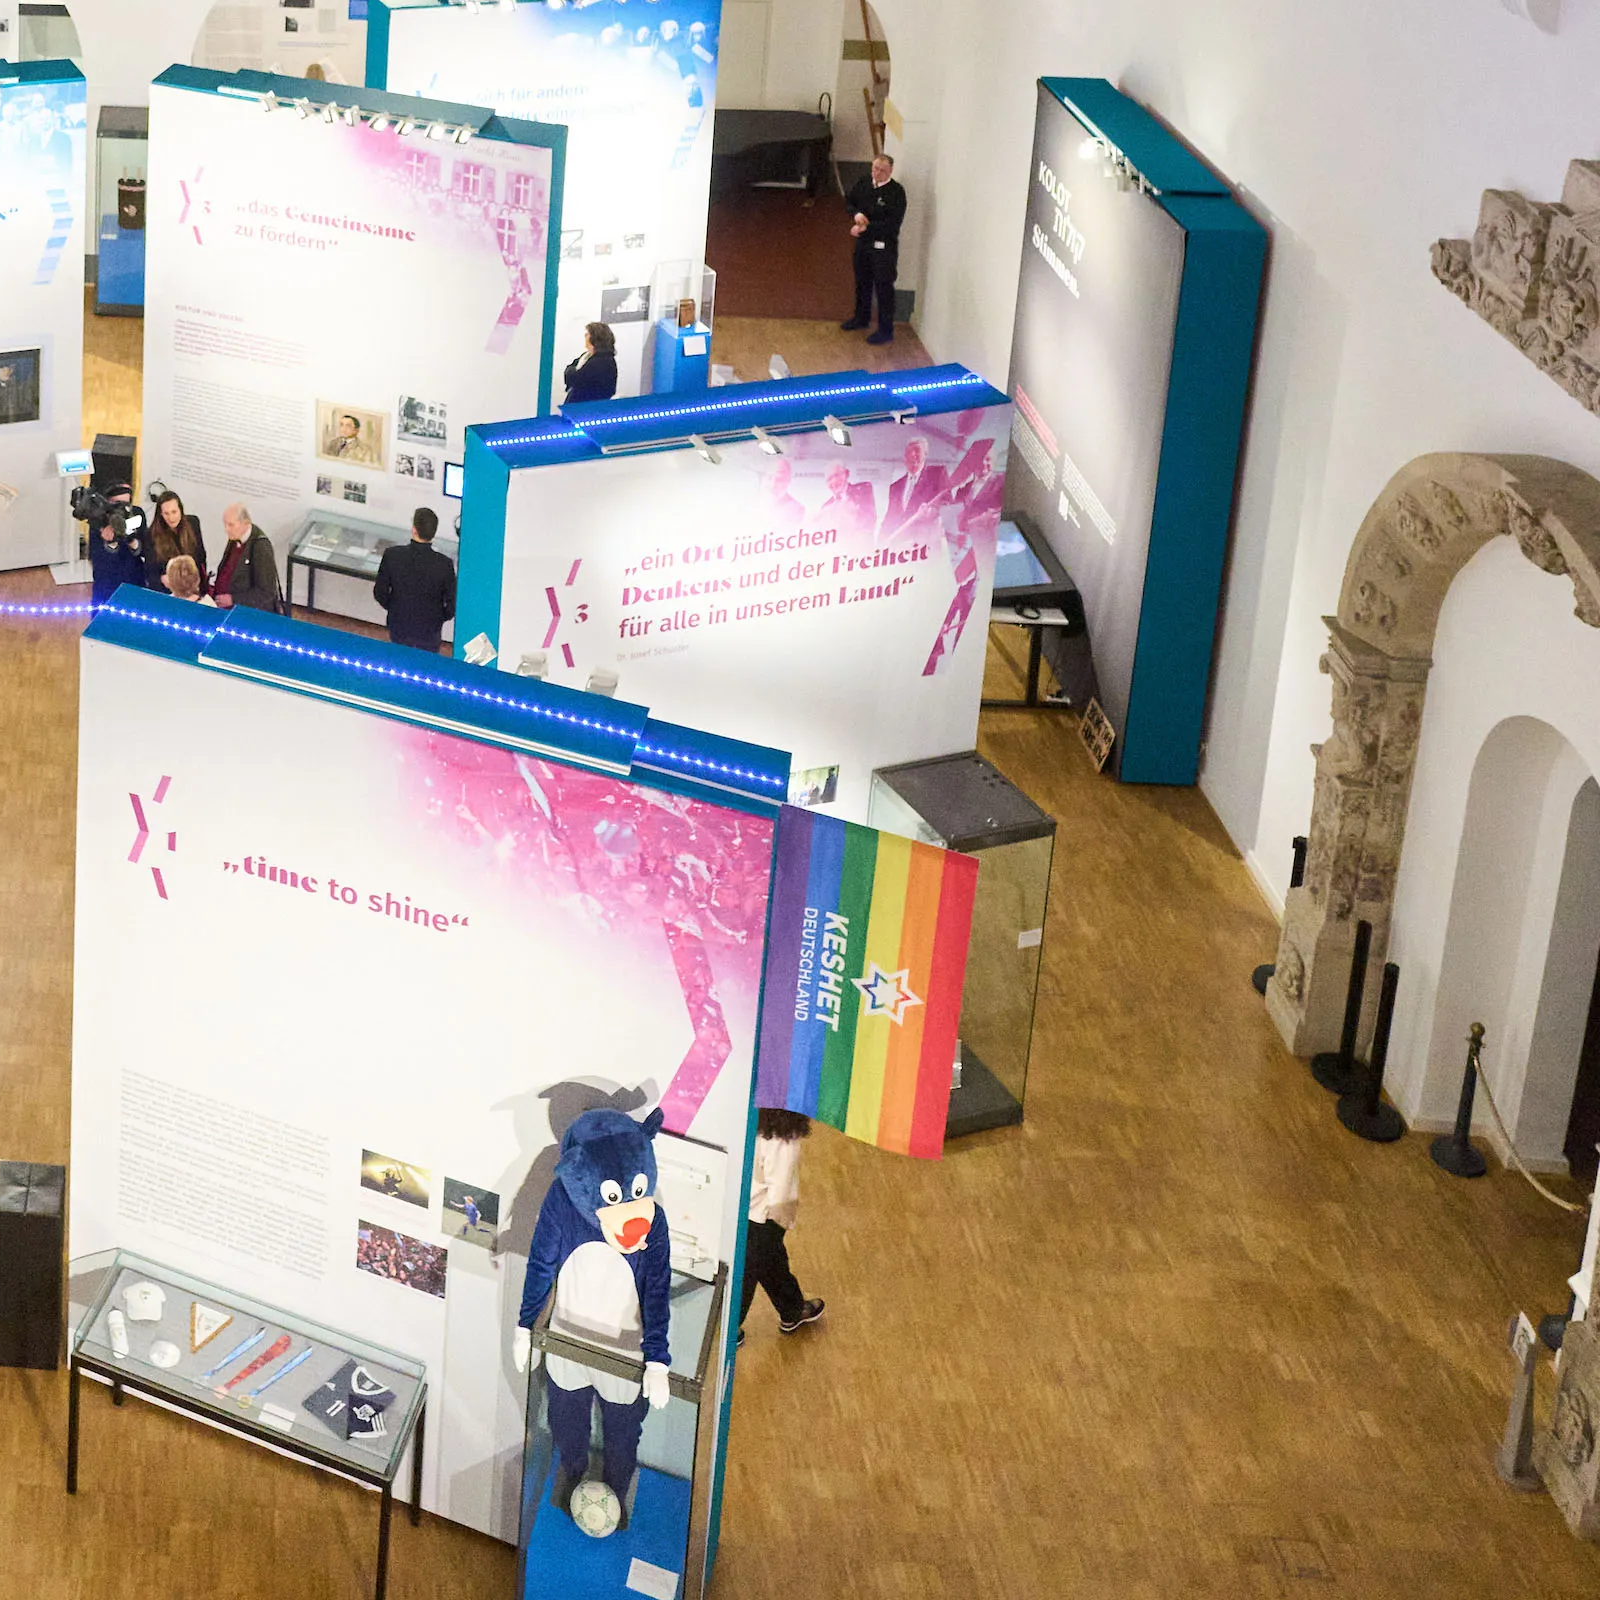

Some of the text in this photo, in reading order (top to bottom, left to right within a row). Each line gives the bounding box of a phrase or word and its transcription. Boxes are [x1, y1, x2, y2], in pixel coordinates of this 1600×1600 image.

[1039, 161, 1072, 213] KOLOT
[234, 223, 339, 251] zu fördern“
[284, 205, 416, 242] Gemeinsame
[1032, 224, 1080, 299] Stimmen.
[620, 543, 931, 606] Denkens und der Freiheit
[623, 527, 837, 576] „ein Ort jüdischen
[618, 574, 916, 639] für alle in unserem Land“
[223, 855, 471, 933] „time to shine“
[793, 907, 819, 1022] DEUTSCHLAND
[815, 910, 850, 1033] KESHET
